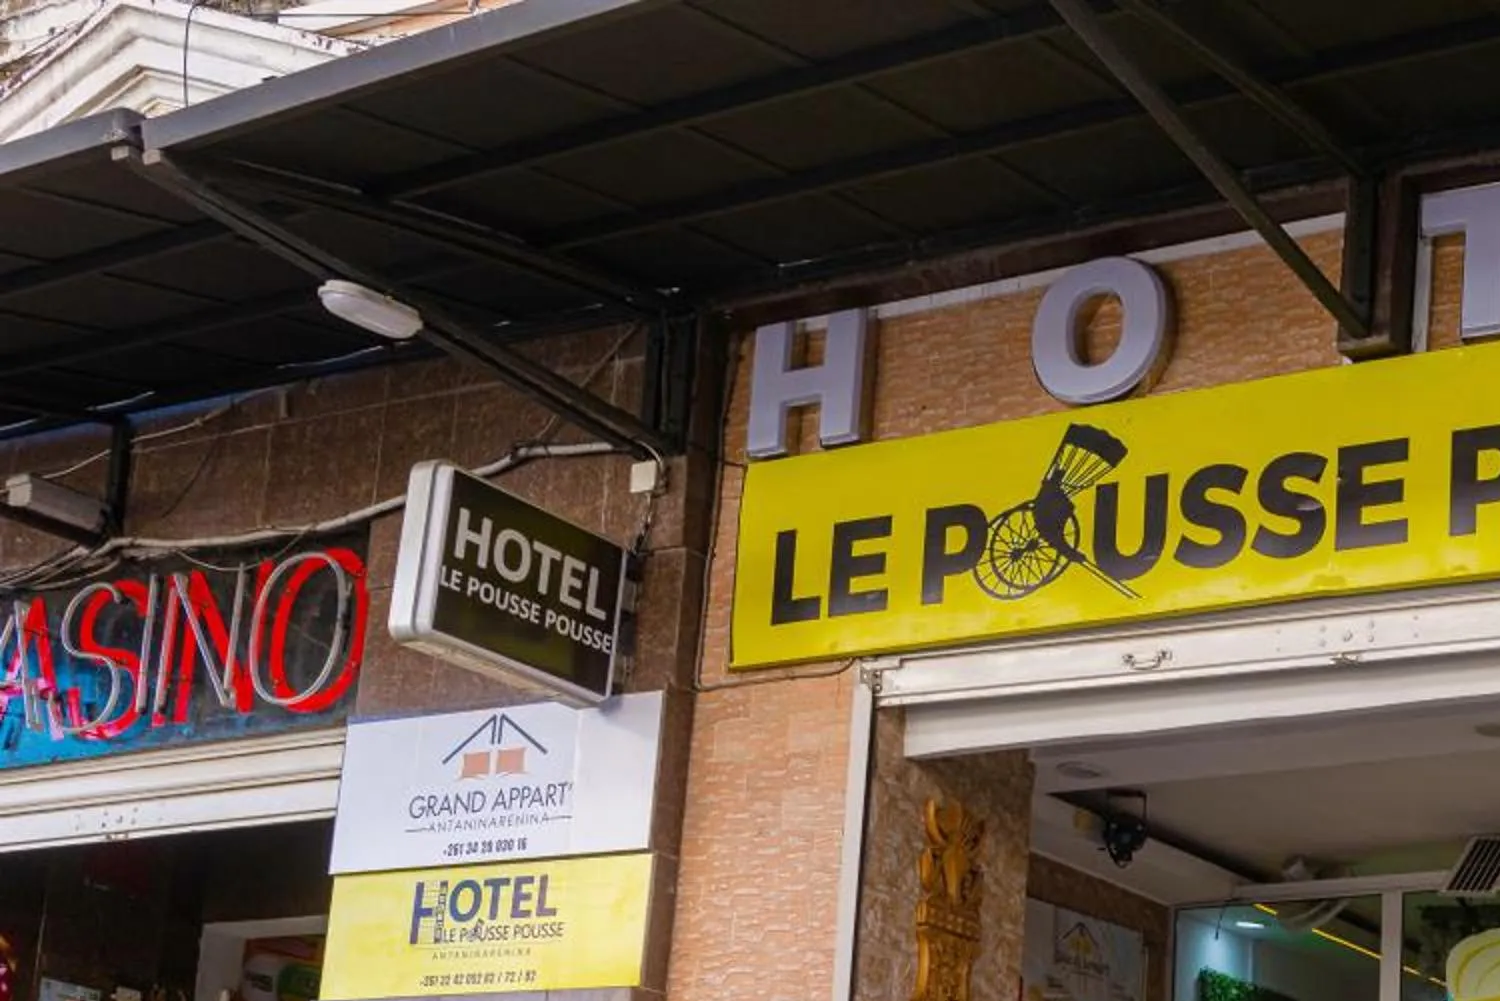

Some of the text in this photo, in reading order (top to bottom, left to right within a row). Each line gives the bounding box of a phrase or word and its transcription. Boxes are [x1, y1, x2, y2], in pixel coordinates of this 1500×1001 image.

[454, 507, 607, 621] HOTEL
[770, 514, 893, 625] LE
[440, 565, 613, 653] LE POUSSE POUSSE
[408, 791, 487, 819] GRAND
[409, 874, 558, 944] HOTEL
[513, 921, 566, 940] POUSSE
